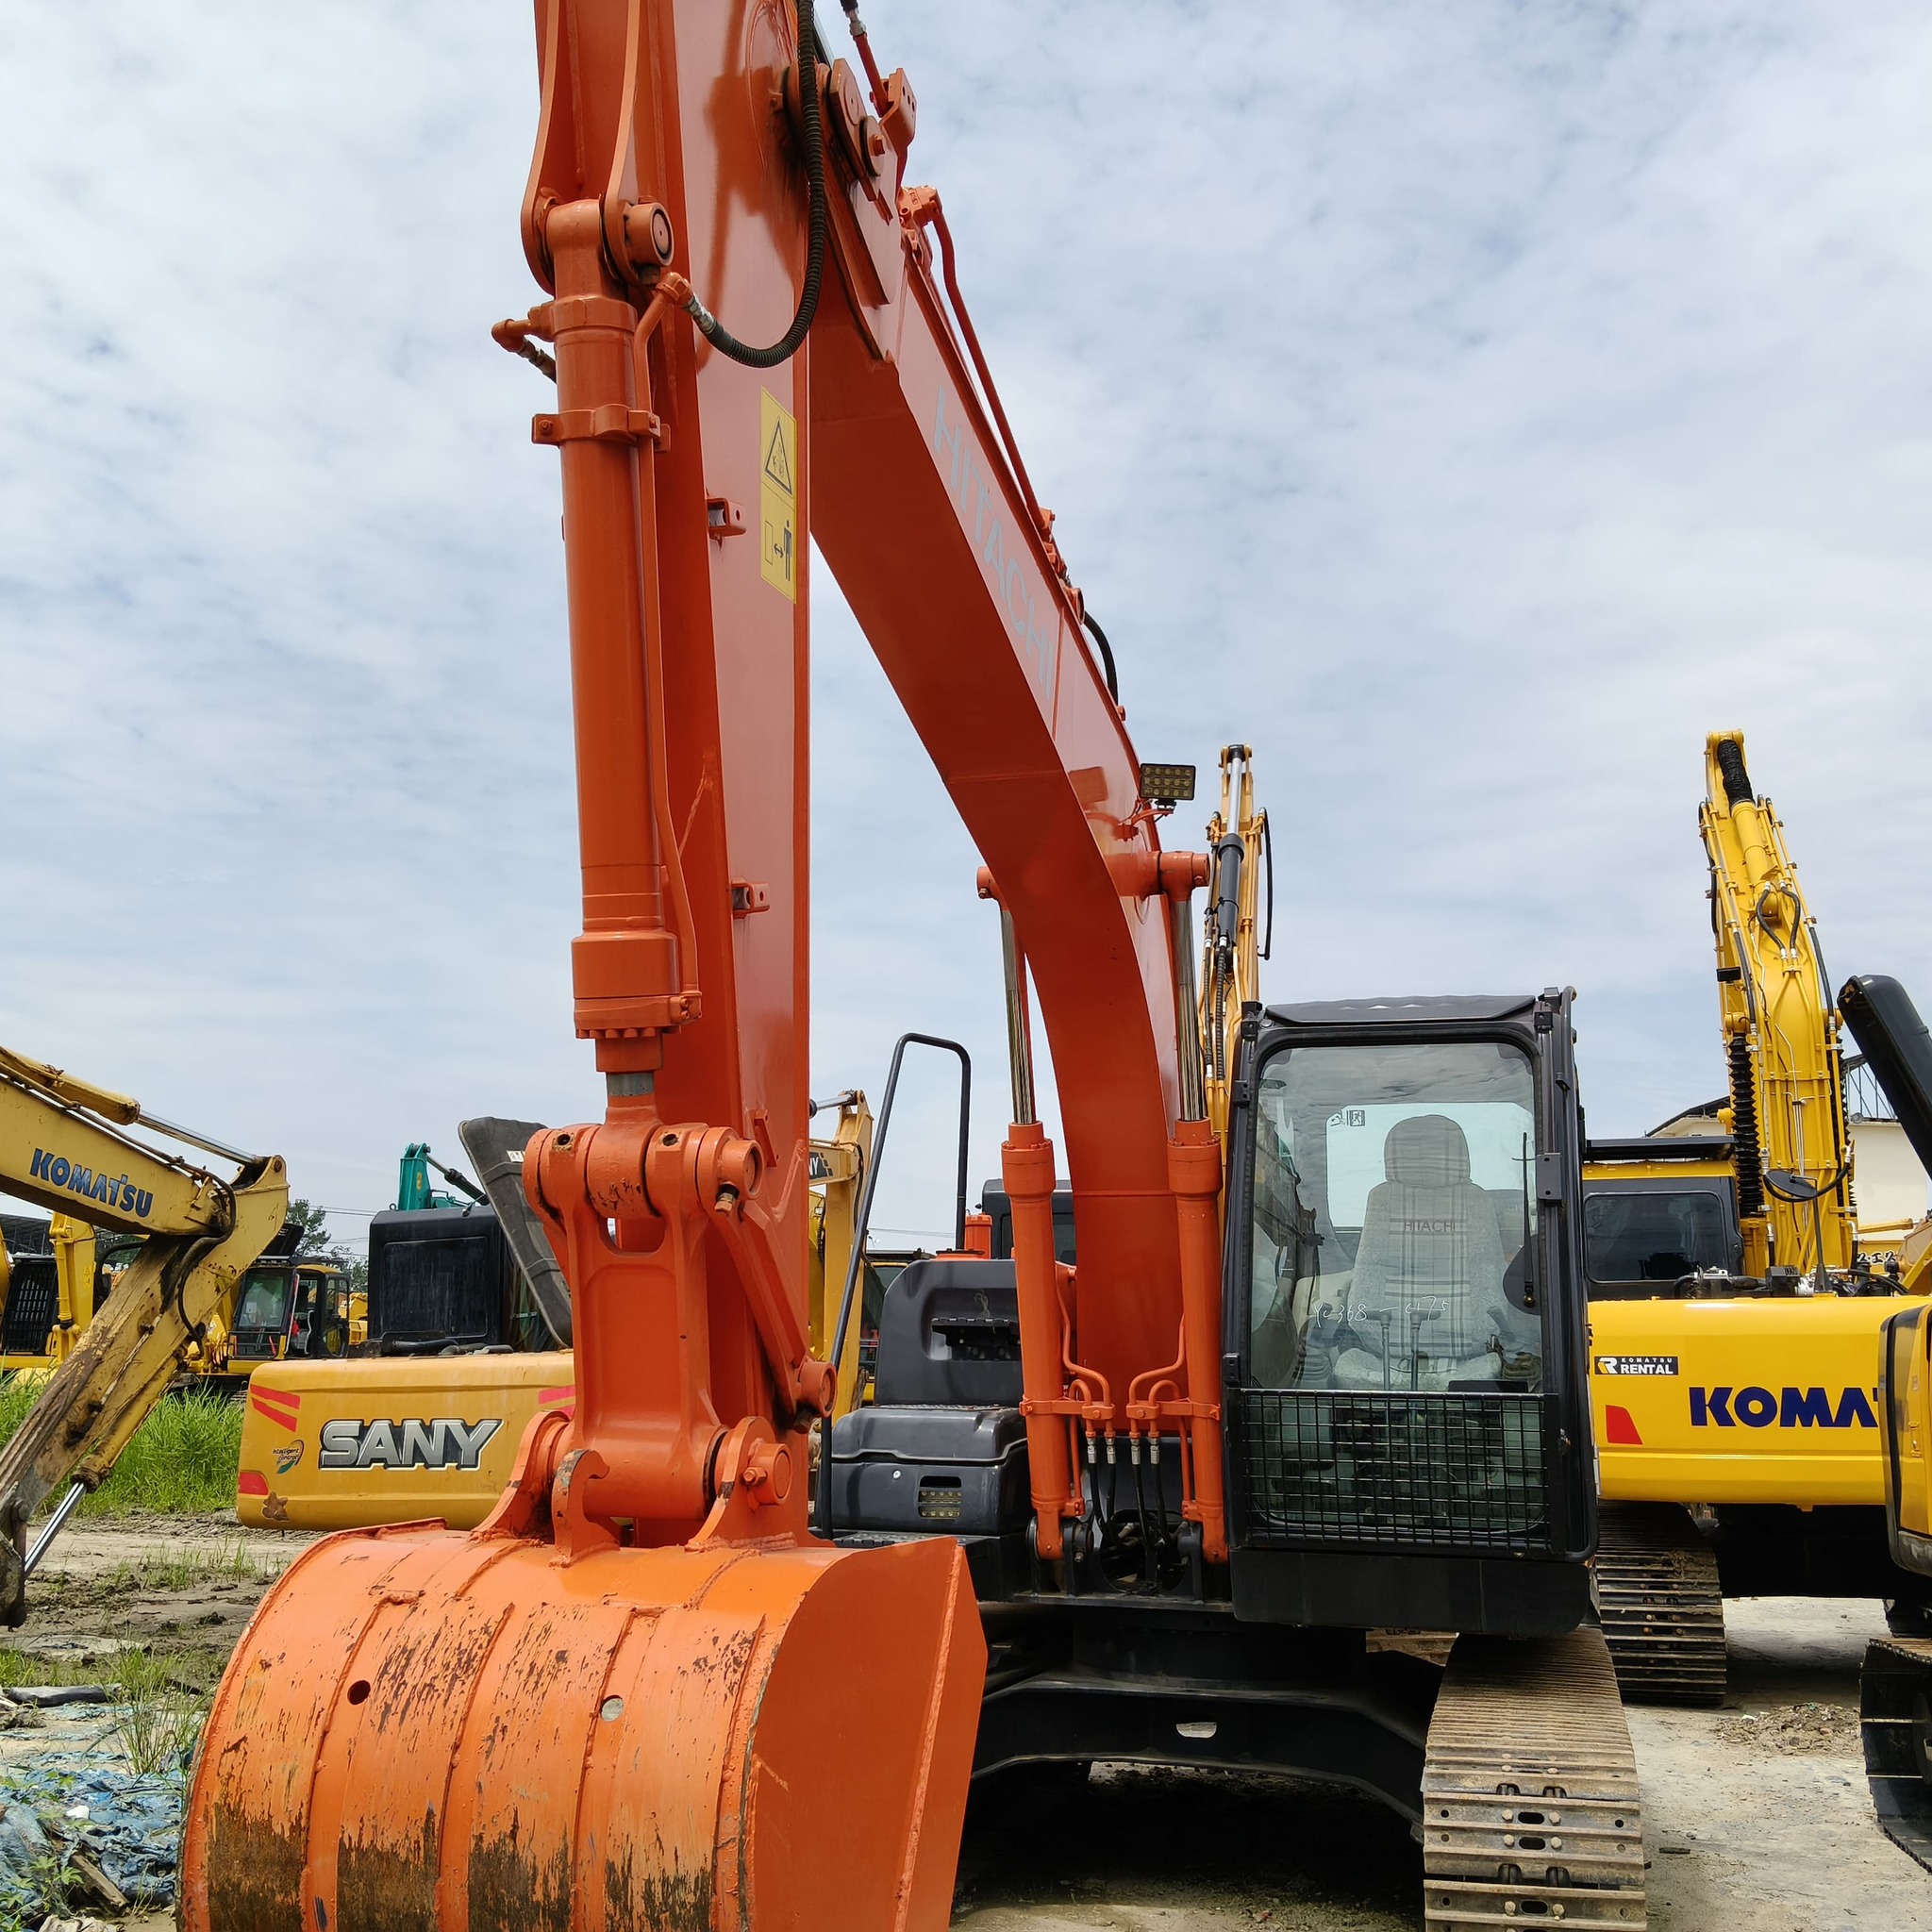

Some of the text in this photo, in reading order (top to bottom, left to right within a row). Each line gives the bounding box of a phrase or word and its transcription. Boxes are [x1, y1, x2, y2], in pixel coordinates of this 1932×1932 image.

[934, 382, 1056, 701] HITACHI
[29, 1147, 153, 1217] KOMATSU
[1404, 1220, 1456, 1232] HITACHI
[1620, 1364, 1674, 1374] RENTAL
[1689, 1386, 1879, 1427] KOMA
[319, 1418, 504, 1471] SANY
